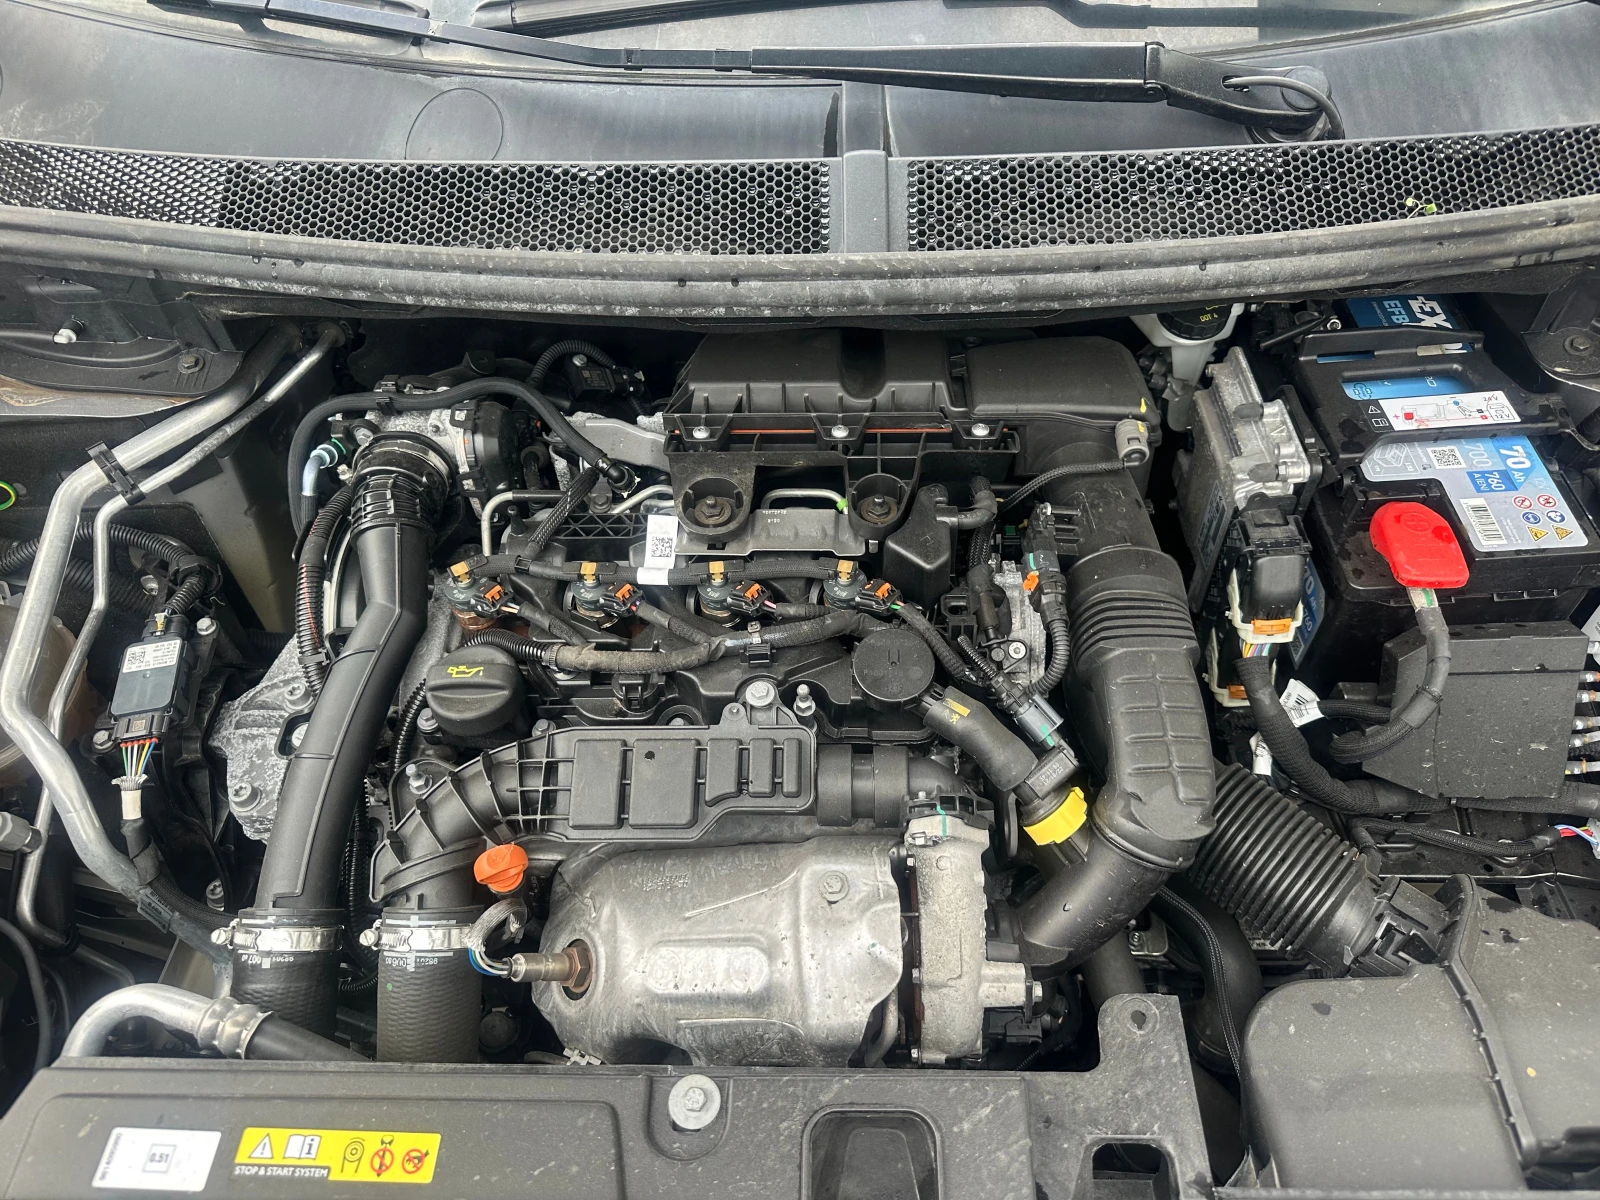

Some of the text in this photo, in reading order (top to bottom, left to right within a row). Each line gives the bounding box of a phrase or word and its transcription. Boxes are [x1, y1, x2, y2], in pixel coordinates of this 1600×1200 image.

[1200, 313, 1211, 322] DOT
[1382, 300, 1410, 324] EFB
[1461, 439, 1492, 467] 700
[1499, 445, 1532, 483] 70 Ah
[1484, 471, 1506, 491] 760
[1303, 608, 1313, 631] 760
[234, 1165, 328, 1178] STOP & START SYSTEM
